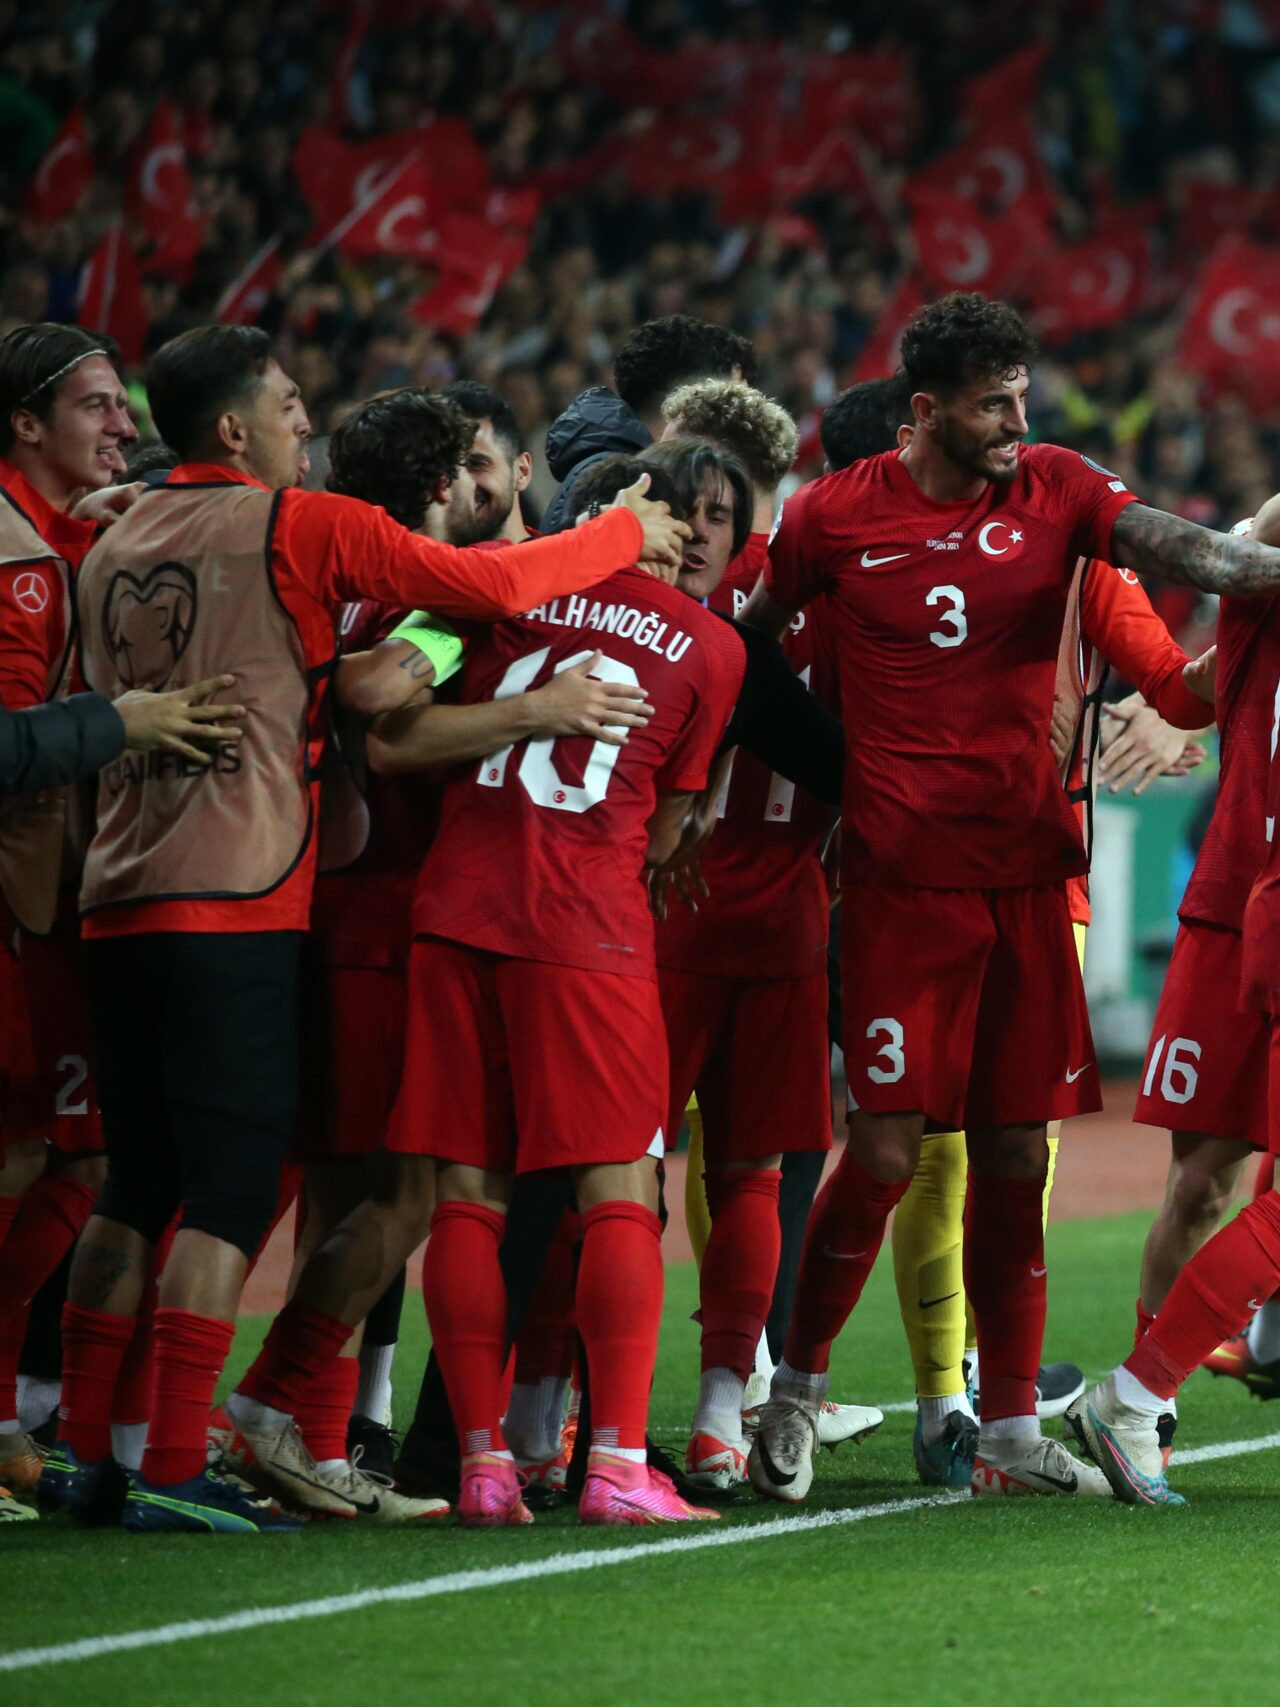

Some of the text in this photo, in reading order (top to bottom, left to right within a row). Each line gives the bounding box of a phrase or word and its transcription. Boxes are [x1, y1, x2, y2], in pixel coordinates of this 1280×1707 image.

[516, 594, 693, 663] ALHANOĞLU
[926, 584, 968, 648] 3
[476, 645, 642, 814] 10
[866, 1017, 906, 1085] 3
[1142, 1033, 1202, 1104] 16
